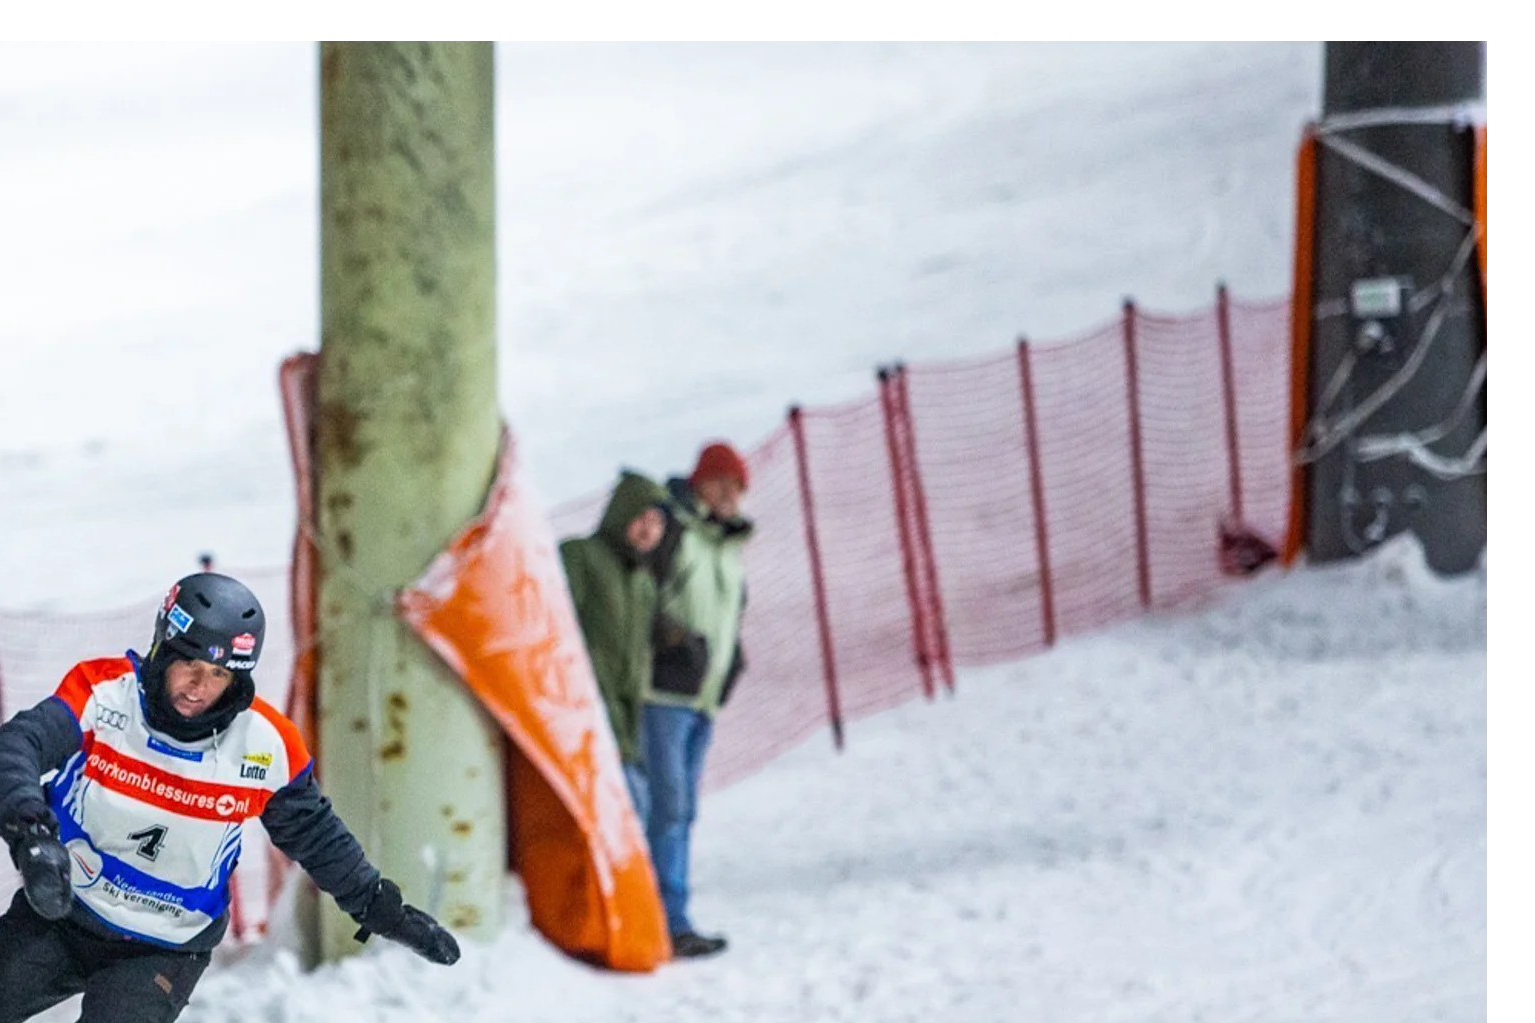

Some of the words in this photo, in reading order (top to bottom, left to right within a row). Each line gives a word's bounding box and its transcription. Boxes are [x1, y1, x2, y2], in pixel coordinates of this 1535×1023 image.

[240, 763, 267, 780] Lotto
[127, 824, 169, 862] 1
[102, 882, 120, 898] Ski
